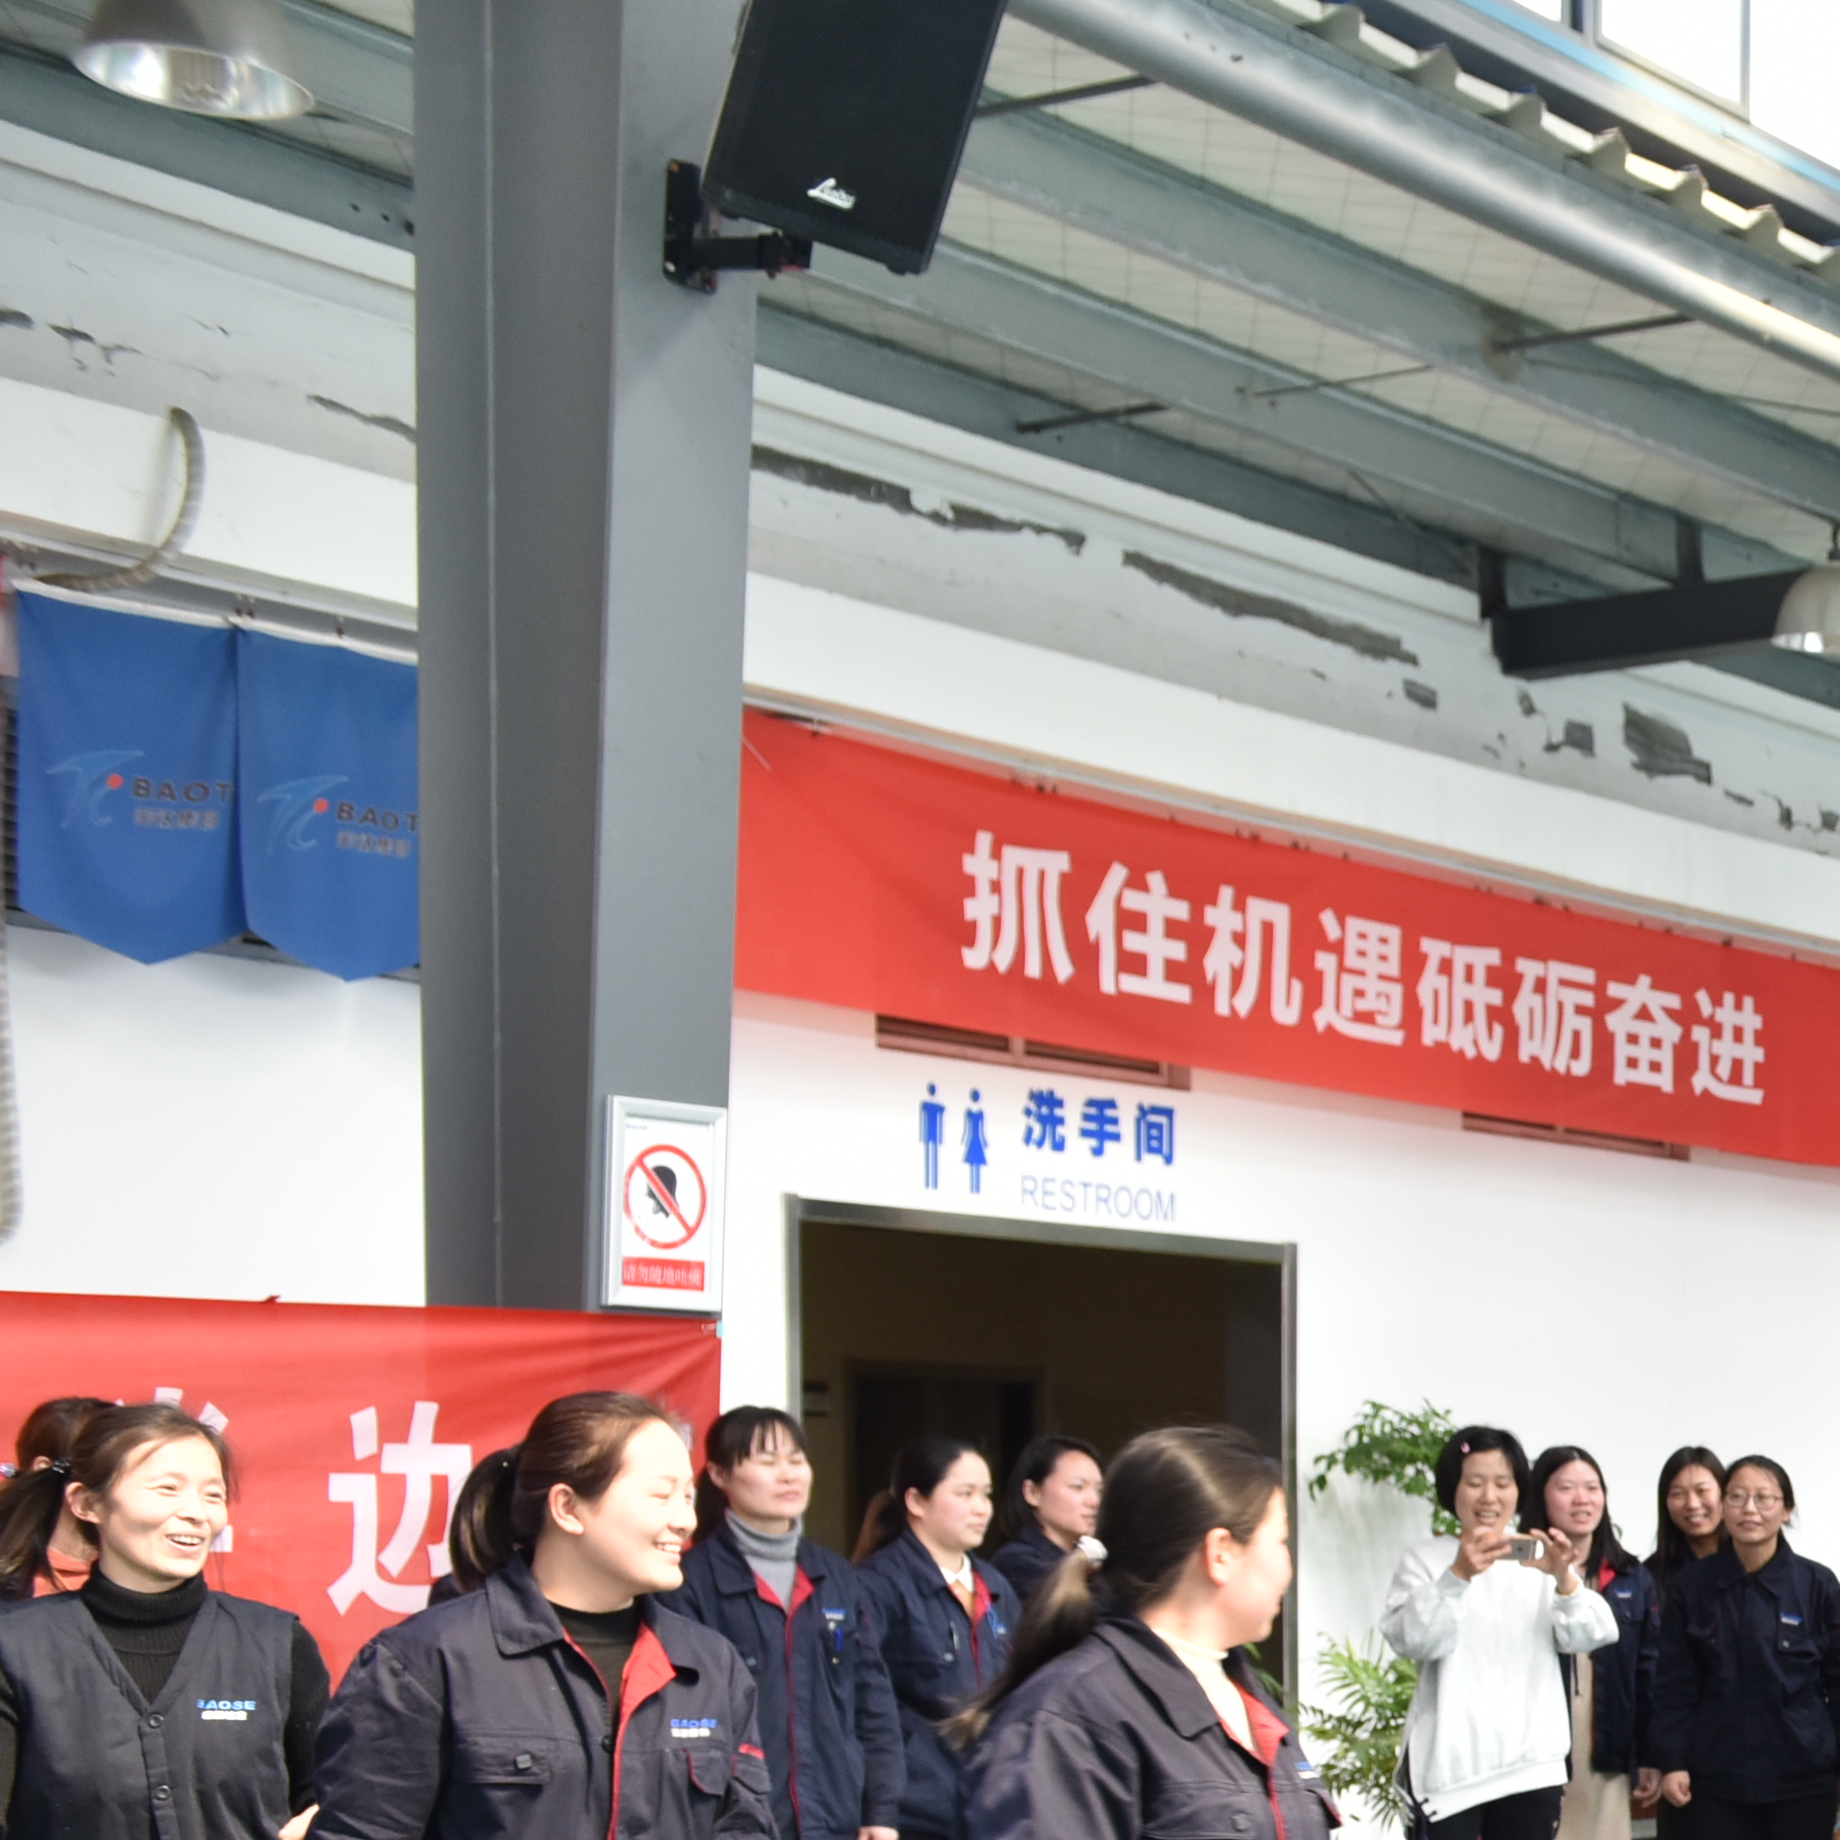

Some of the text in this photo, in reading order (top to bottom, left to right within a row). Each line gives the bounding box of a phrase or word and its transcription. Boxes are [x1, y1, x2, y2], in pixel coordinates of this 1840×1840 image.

[961, 830, 1765, 1105] 抓住机遇砥砺奋进
[1023, 1088, 1175, 1166] 洗手间
[1021, 1174, 1176, 1221] RESTROOM
